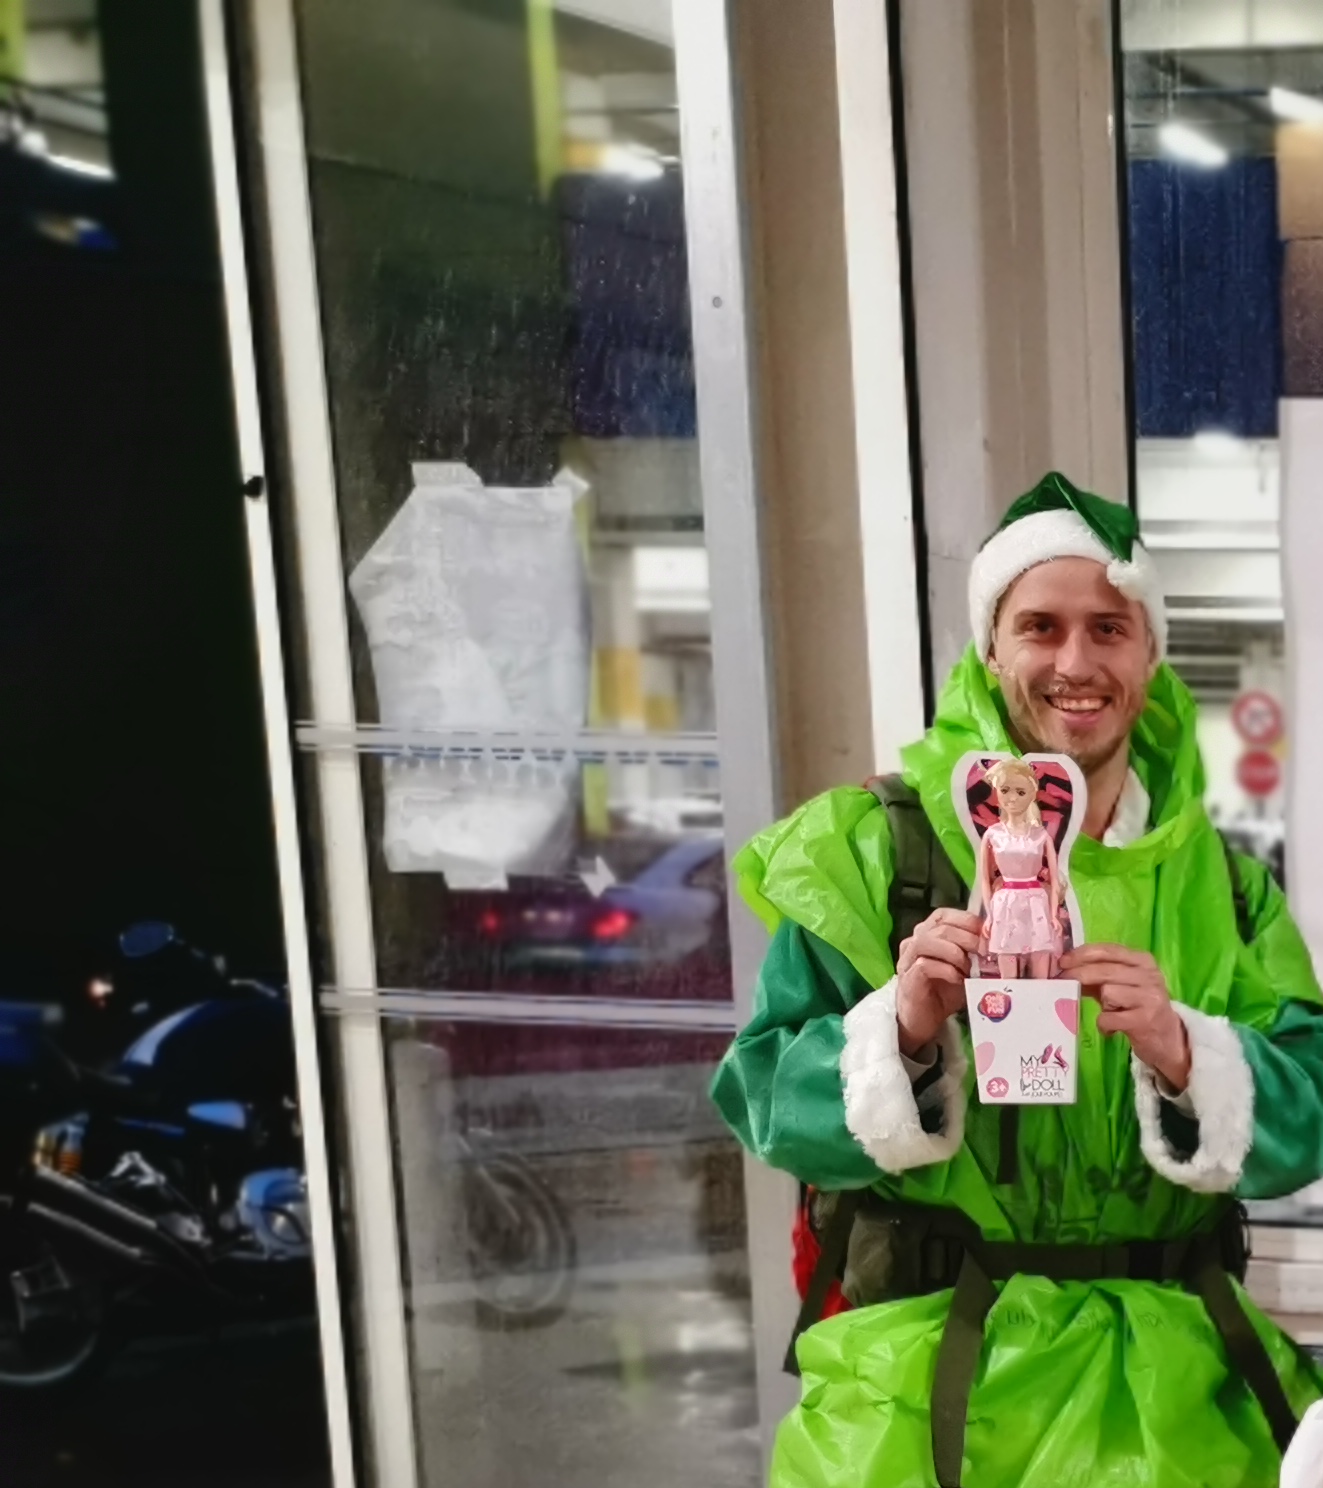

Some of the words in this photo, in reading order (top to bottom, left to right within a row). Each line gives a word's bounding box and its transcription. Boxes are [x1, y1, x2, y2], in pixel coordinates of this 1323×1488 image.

[1020, 1055, 1043, 1067] MY
[1021, 1066, 1069, 1077] PRETTY
[989, 1080, 1006, 1093] 3+
[1032, 1079, 1065, 1091] DOLL
